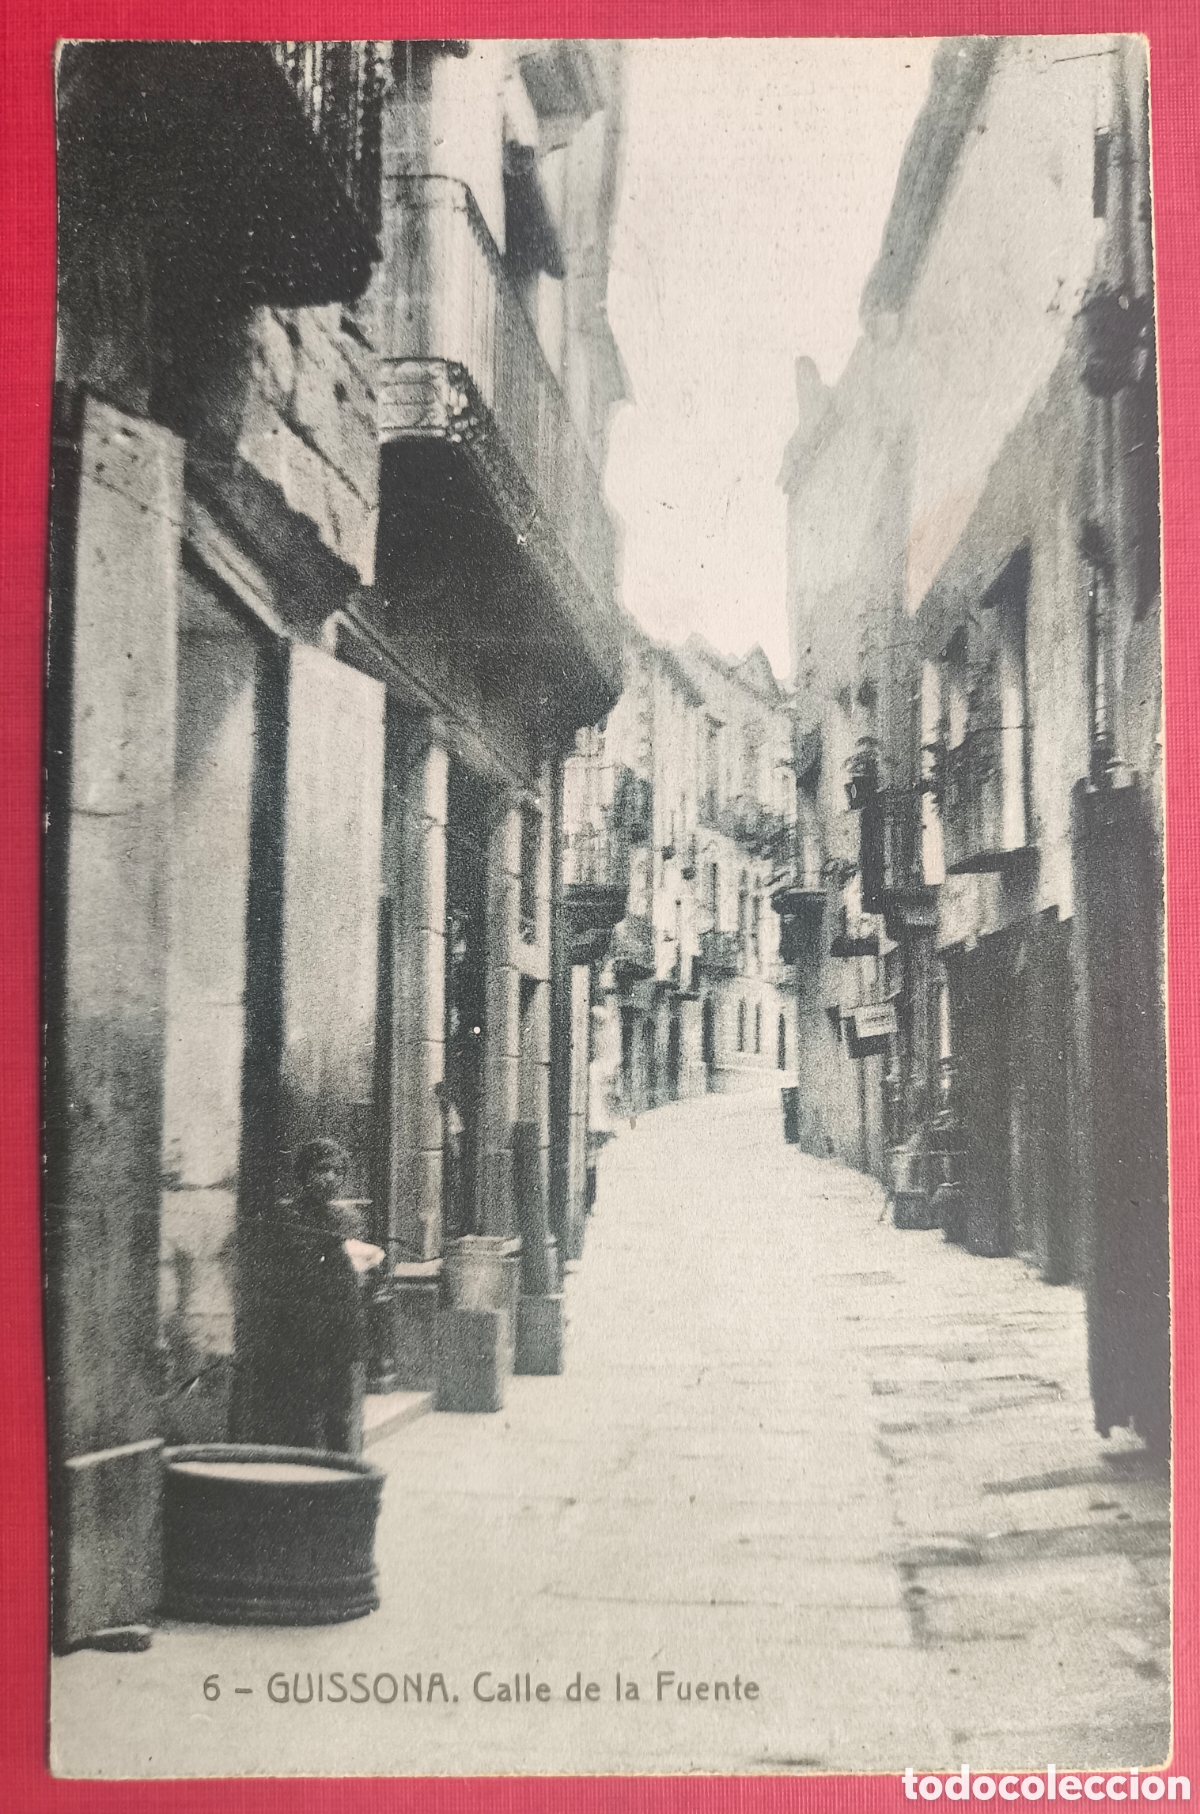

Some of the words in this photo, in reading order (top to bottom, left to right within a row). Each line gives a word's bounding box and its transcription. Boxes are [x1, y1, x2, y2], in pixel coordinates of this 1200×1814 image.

[203, 1673, 221, 1702] 6
[266, 1671, 460, 1704] GUISSONA.
[472, 1671, 552, 1703] Calle
[565, 1672, 600, 1703] de
[615, 1673, 641, 1702] la
[656, 1670, 761, 1702] Fuente
